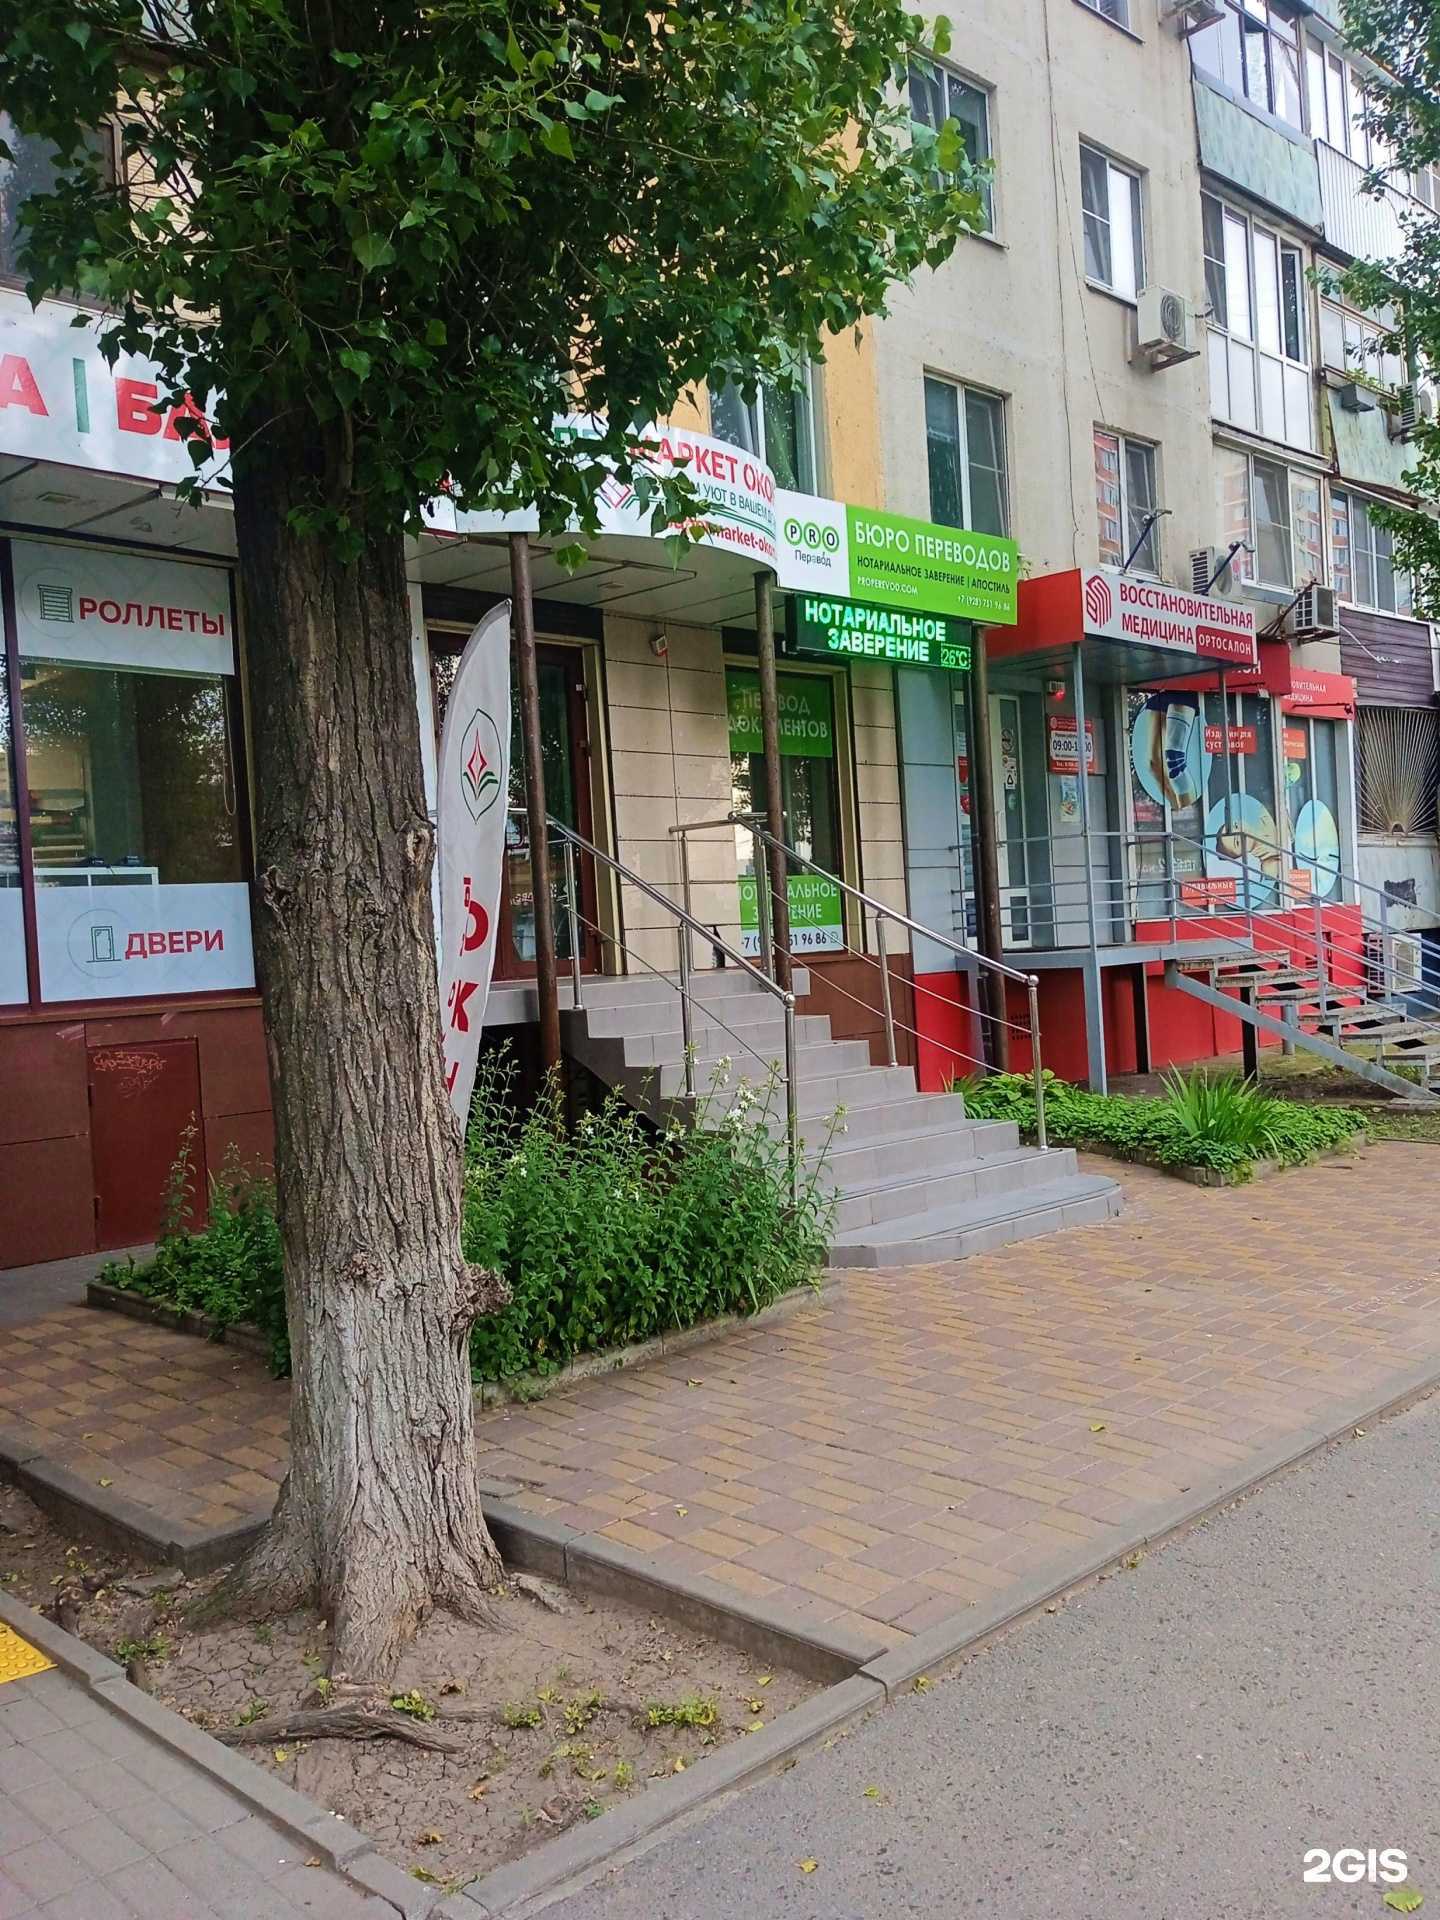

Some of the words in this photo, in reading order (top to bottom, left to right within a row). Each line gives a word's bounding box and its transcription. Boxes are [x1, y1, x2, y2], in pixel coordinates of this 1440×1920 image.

[630, 436, 738, 483] АРКЕТ
[703, 483, 727, 502] УЮТ
[730, 491, 736, 506] В
[787, 521, 837, 549] PRO
[854, 521, 910, 553] БЮРО
[914, 534, 1010, 573] ПЕРЕВОДОВ
[856, 555, 922, 578] НОТАРИАЛЬНОЕ
[924, 568, 965, 586] ЗАВЕРЕНИЕ
[971, 578, 1010, 594] АПОСТИЛЬ
[79, 597, 225, 636] РОЛЛЕТЫ
[804, 599, 946, 642] НОТАРИАЛЬНОЕ
[1119, 583, 1253, 630] ВОССТАНОВИТЕЛЬНАЯ
[827, 627, 930, 662] ЗАВЕРЕНИЕ
[1121, 612, 1194, 645] МЕДИЦИНА
[1198, 633, 1252, 656] ОРТОСАЛОН
[742, 687, 811, 715] ПЕВОД
[124, 929, 224, 960] ДВЕРИ
[801, 933, 813, 945] 96
[815, 932, 827, 945] 86
